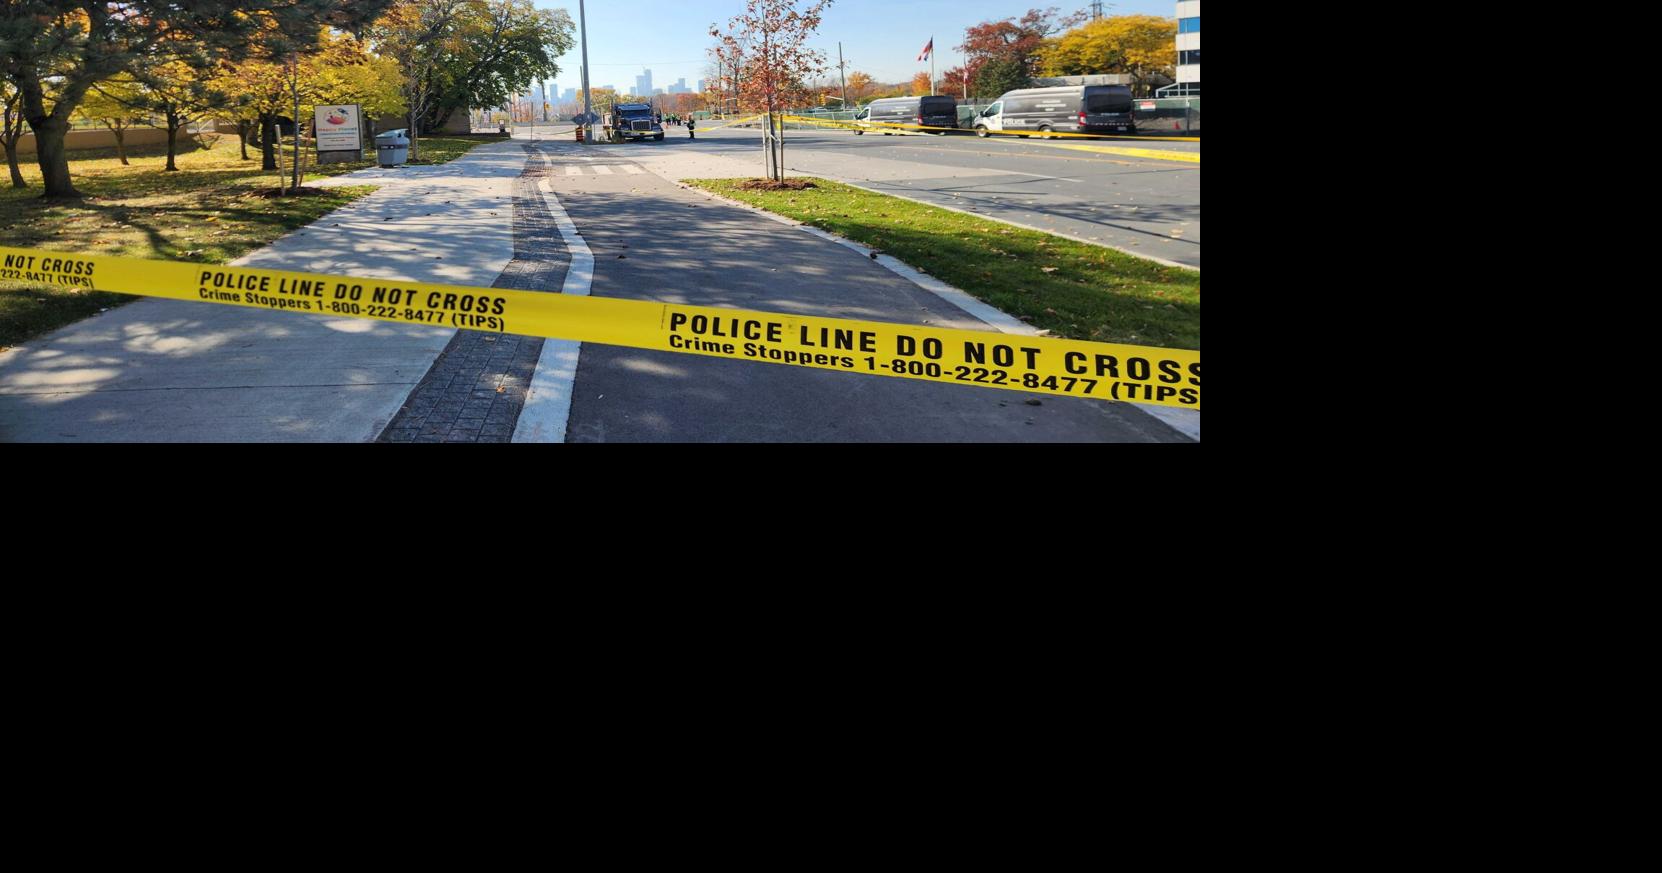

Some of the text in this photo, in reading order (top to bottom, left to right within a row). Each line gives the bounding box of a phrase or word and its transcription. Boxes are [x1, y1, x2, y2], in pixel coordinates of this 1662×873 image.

[4, 254, 95, 276] NOT CROSS
[57, 274, 95, 289] (TIPS)
[199, 287, 505, 332] Crime Stoppers 1-800-222-8477 (TIPS)
[200, 271, 507, 316] POLICE LINE DO NOT CROSS
[670, 312, 782, 343] POLICE
[800, 325, 877, 353] LINE
[897, 335, 943, 360] DO
[964, 341, 1042, 370] NOT
[669, 334, 735, 354] Crime
[743, 342, 855, 367] Stoppers
[863, 356, 1098, 394] 1-800-222-8477
